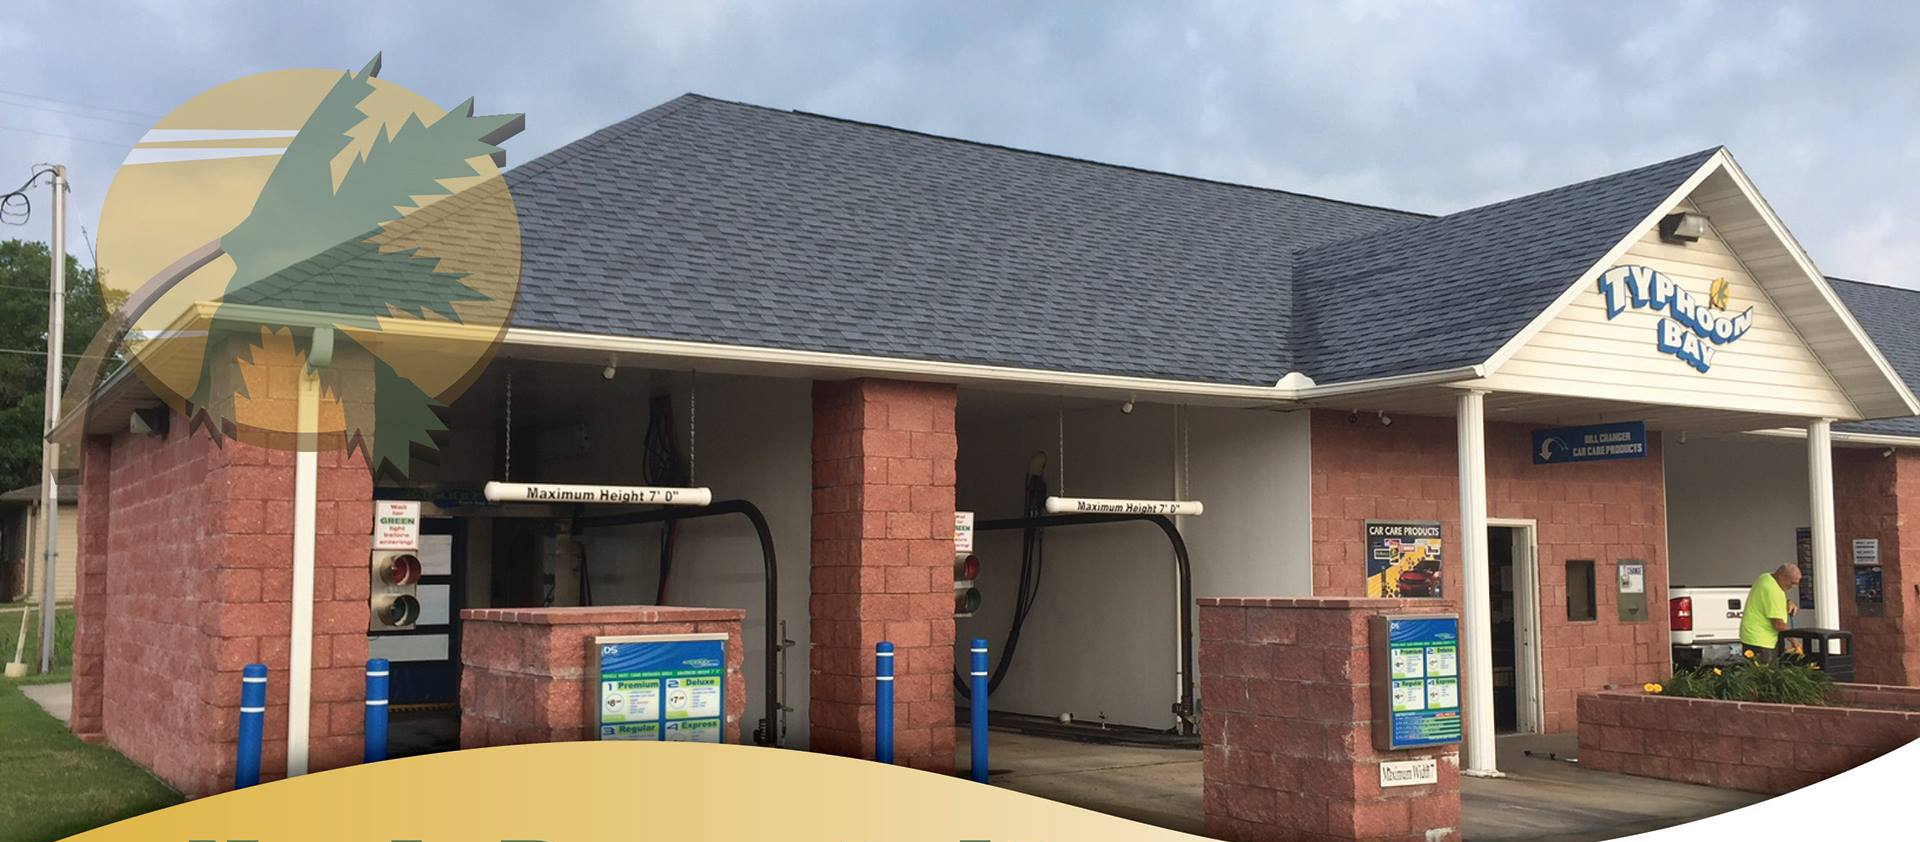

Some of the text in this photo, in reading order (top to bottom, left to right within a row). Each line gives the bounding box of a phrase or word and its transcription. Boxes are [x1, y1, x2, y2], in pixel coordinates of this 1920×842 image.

[1597, 264, 1754, 345] TYPHOON
[1657, 317, 1716, 374] BAY
[1584, 432, 1631, 444] BILL CHANGER
[1572, 443, 1643, 457] CAR CARE PRODUCTS
[526, 487, 595, 501] Maximum
[600, 489, 645, 503] Height
[649, 491, 661, 502] 7'
[1077, 501, 1123, 512] Maximum
[1126, 503, 1157, 514] Height
[380, 517, 415, 525] GREEN
[1369, 526, 1440, 536] CAR CARE PRODUCTS
[607, 681, 659, 691] 1 Premium
[667, 679, 680, 688] 2
[603, 725, 656, 736] 3 Regular
[667, 721, 718, 731] 4 Express
